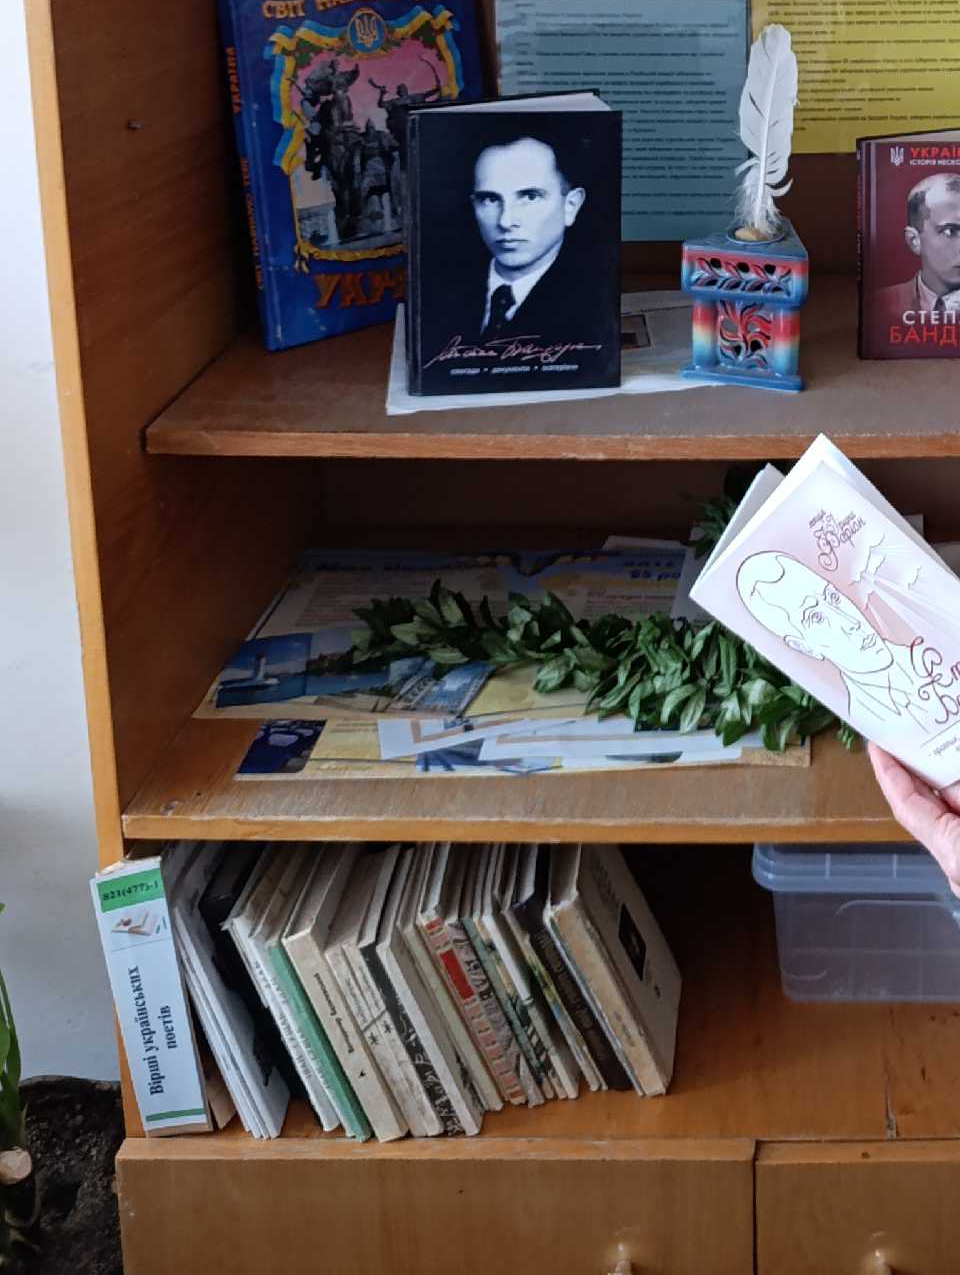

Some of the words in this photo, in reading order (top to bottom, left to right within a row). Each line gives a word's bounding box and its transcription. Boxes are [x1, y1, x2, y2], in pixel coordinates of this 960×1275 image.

[128, 965, 160, 1053] українських
[159, 1004, 179, 1050] поетів
[142, 1054, 164, 1095] Вірші
